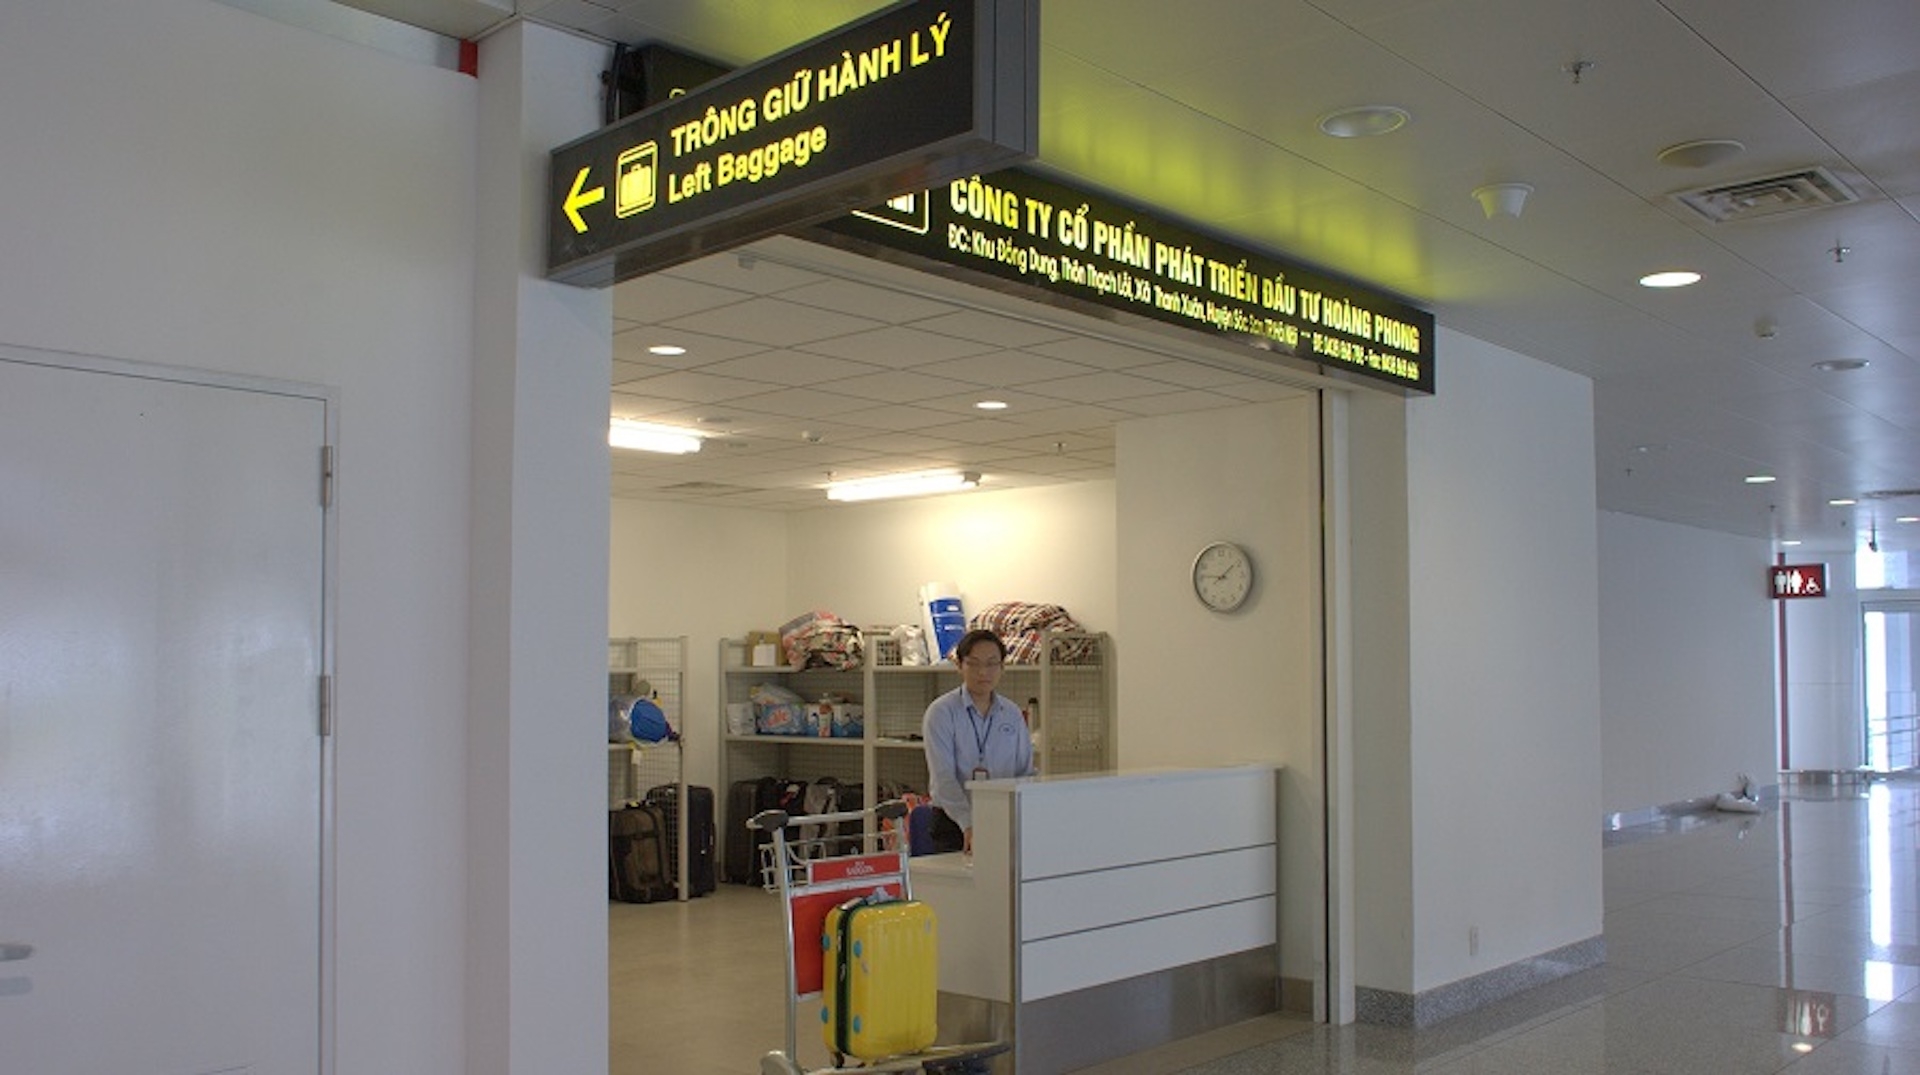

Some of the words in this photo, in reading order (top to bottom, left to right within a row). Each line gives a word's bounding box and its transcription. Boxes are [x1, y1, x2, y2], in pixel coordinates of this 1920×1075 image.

[671, 98, 757, 157] TRÔNG
[763, 69, 813, 122] GIỮ
[818, 39, 902, 102] HÀNH
[911, 12, 951, 67] LÝ
[669, 161, 712, 204] Left
[718, 125, 827, 187] Baggage
[950, 174, 1019, 230] CÔNG
[1025, 197, 1053, 239] TY
[1058, 203, 1089, 251] CỔ
[1155, 242, 1205, 288] PHÁT
[1300, 288, 1322, 324] TƯ
[1323, 298, 1372, 340] HOÀNG
[1374, 314, 1420, 354] PHONG
[972, 230, 995, 260] Khu
[1154, 284, 1180, 313] Thanh
